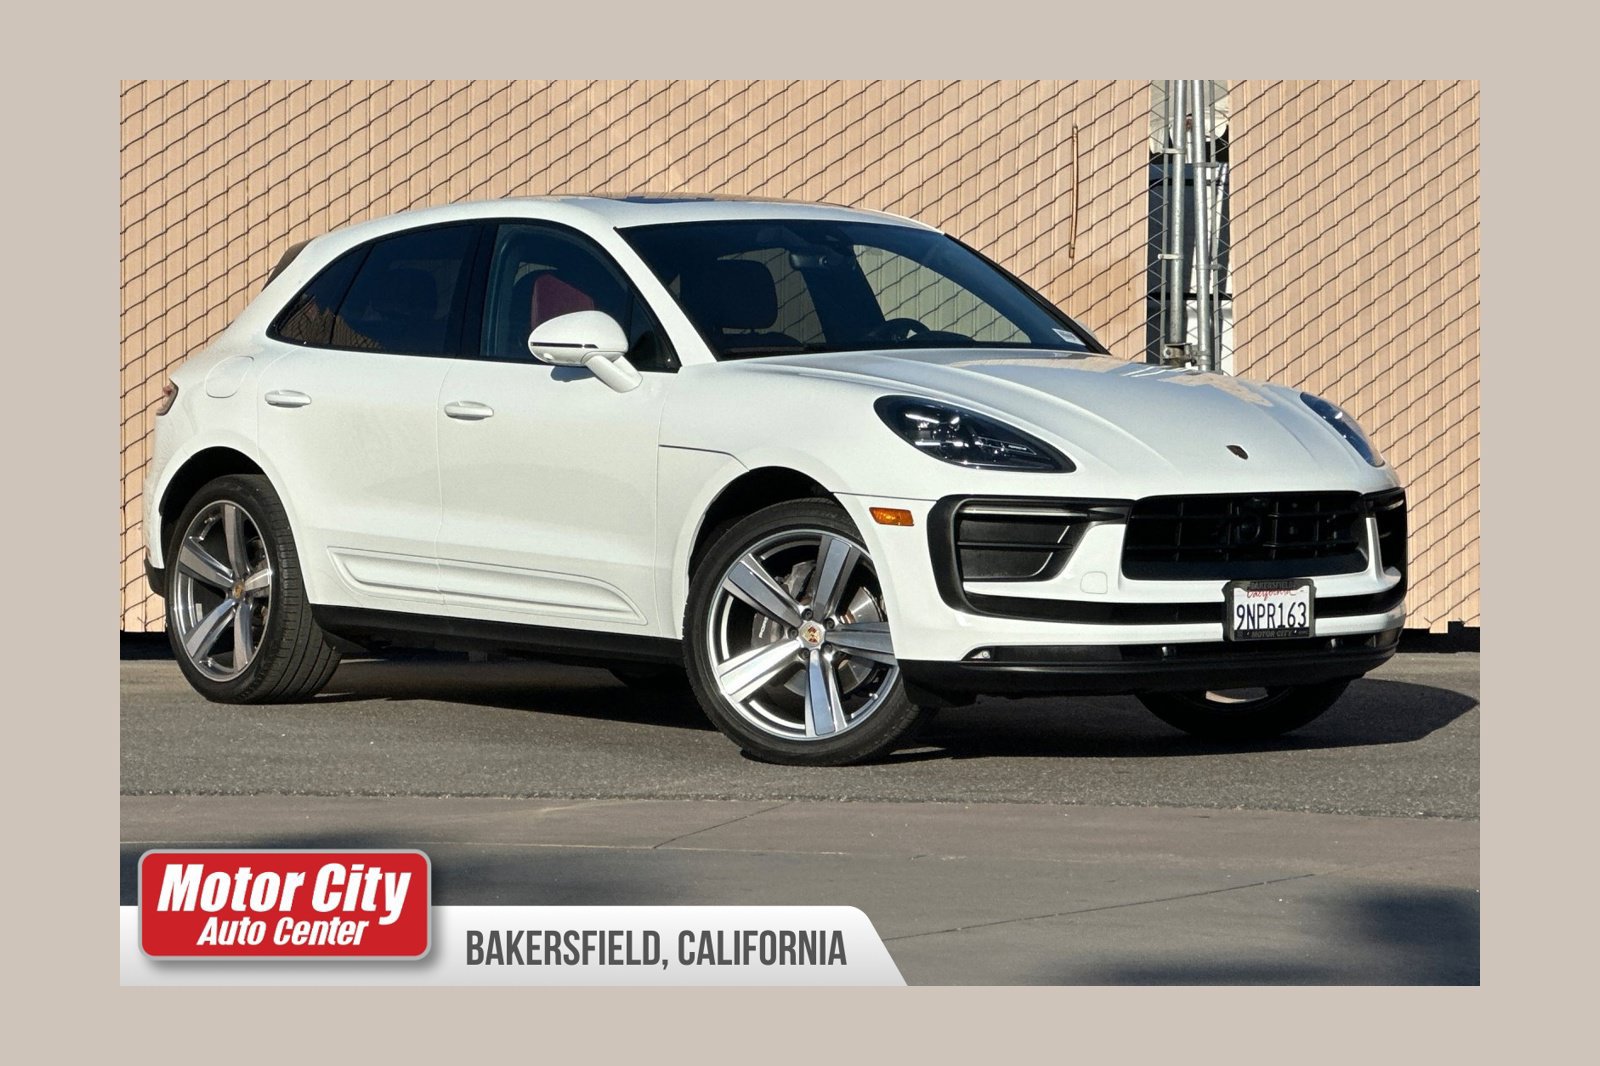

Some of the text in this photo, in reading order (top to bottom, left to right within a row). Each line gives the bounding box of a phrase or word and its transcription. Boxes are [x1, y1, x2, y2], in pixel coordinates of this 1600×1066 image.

[1236, 602, 1306, 630] 9NPR163
[1252, 630, 1275, 638] MOTOR
[1276, 629, 1292, 637] CITY
